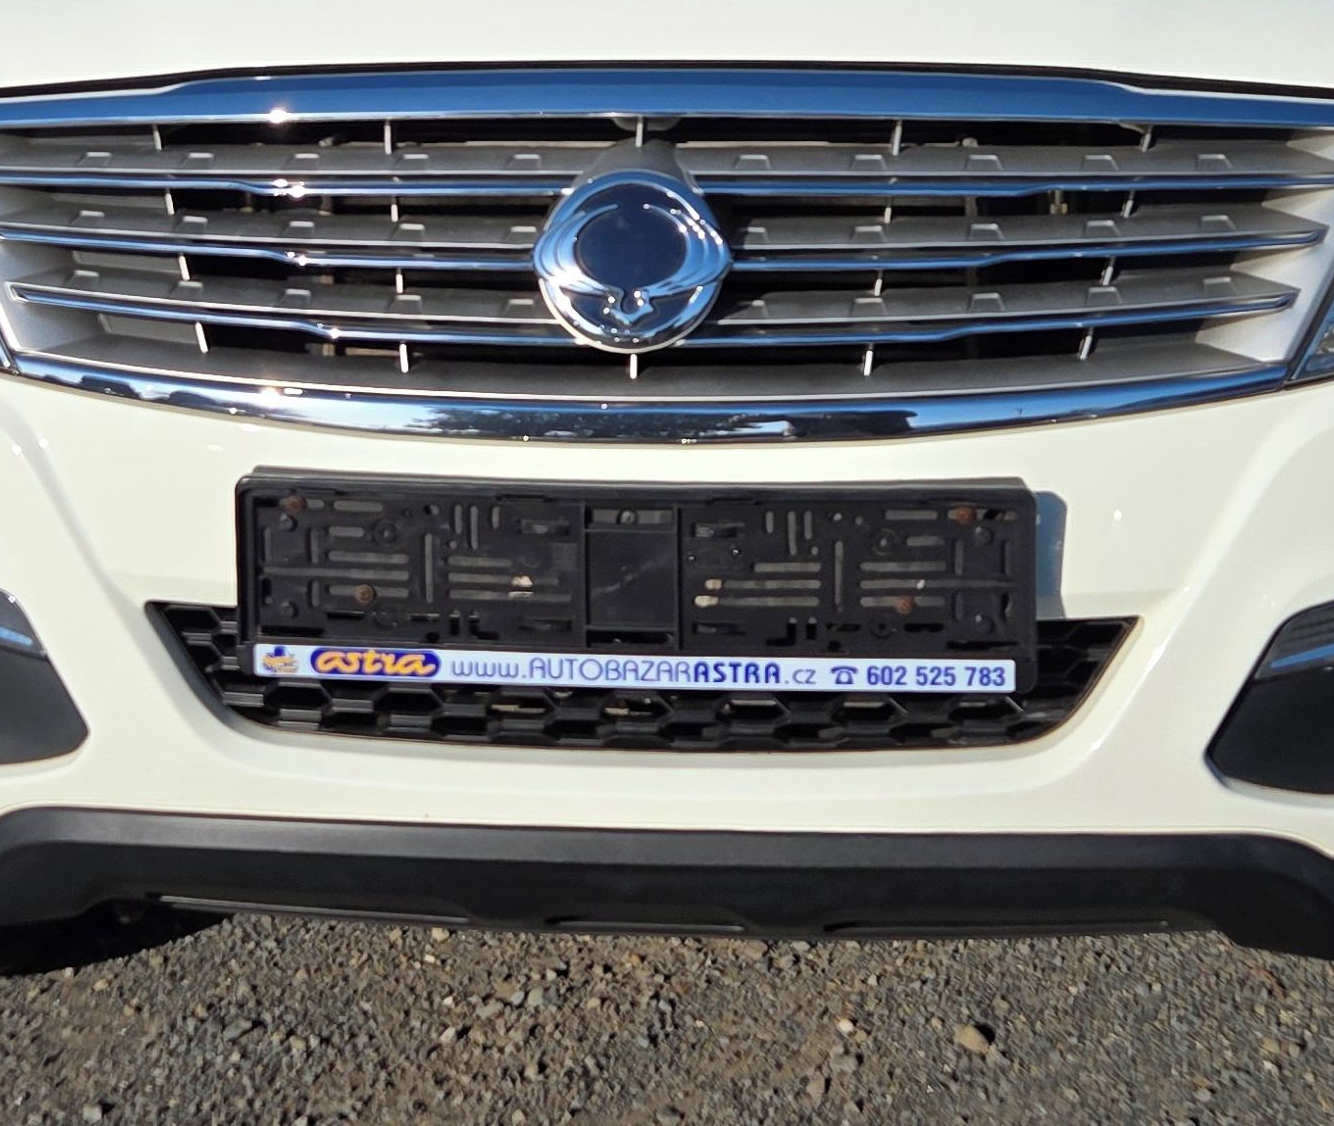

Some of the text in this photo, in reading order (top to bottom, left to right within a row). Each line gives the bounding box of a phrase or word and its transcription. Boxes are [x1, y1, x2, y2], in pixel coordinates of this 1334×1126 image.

[315, 649, 437, 674] astra
[867, 666, 907, 686] 602
[915, 667, 957, 687] 525
[965, 667, 1006, 687] 783
